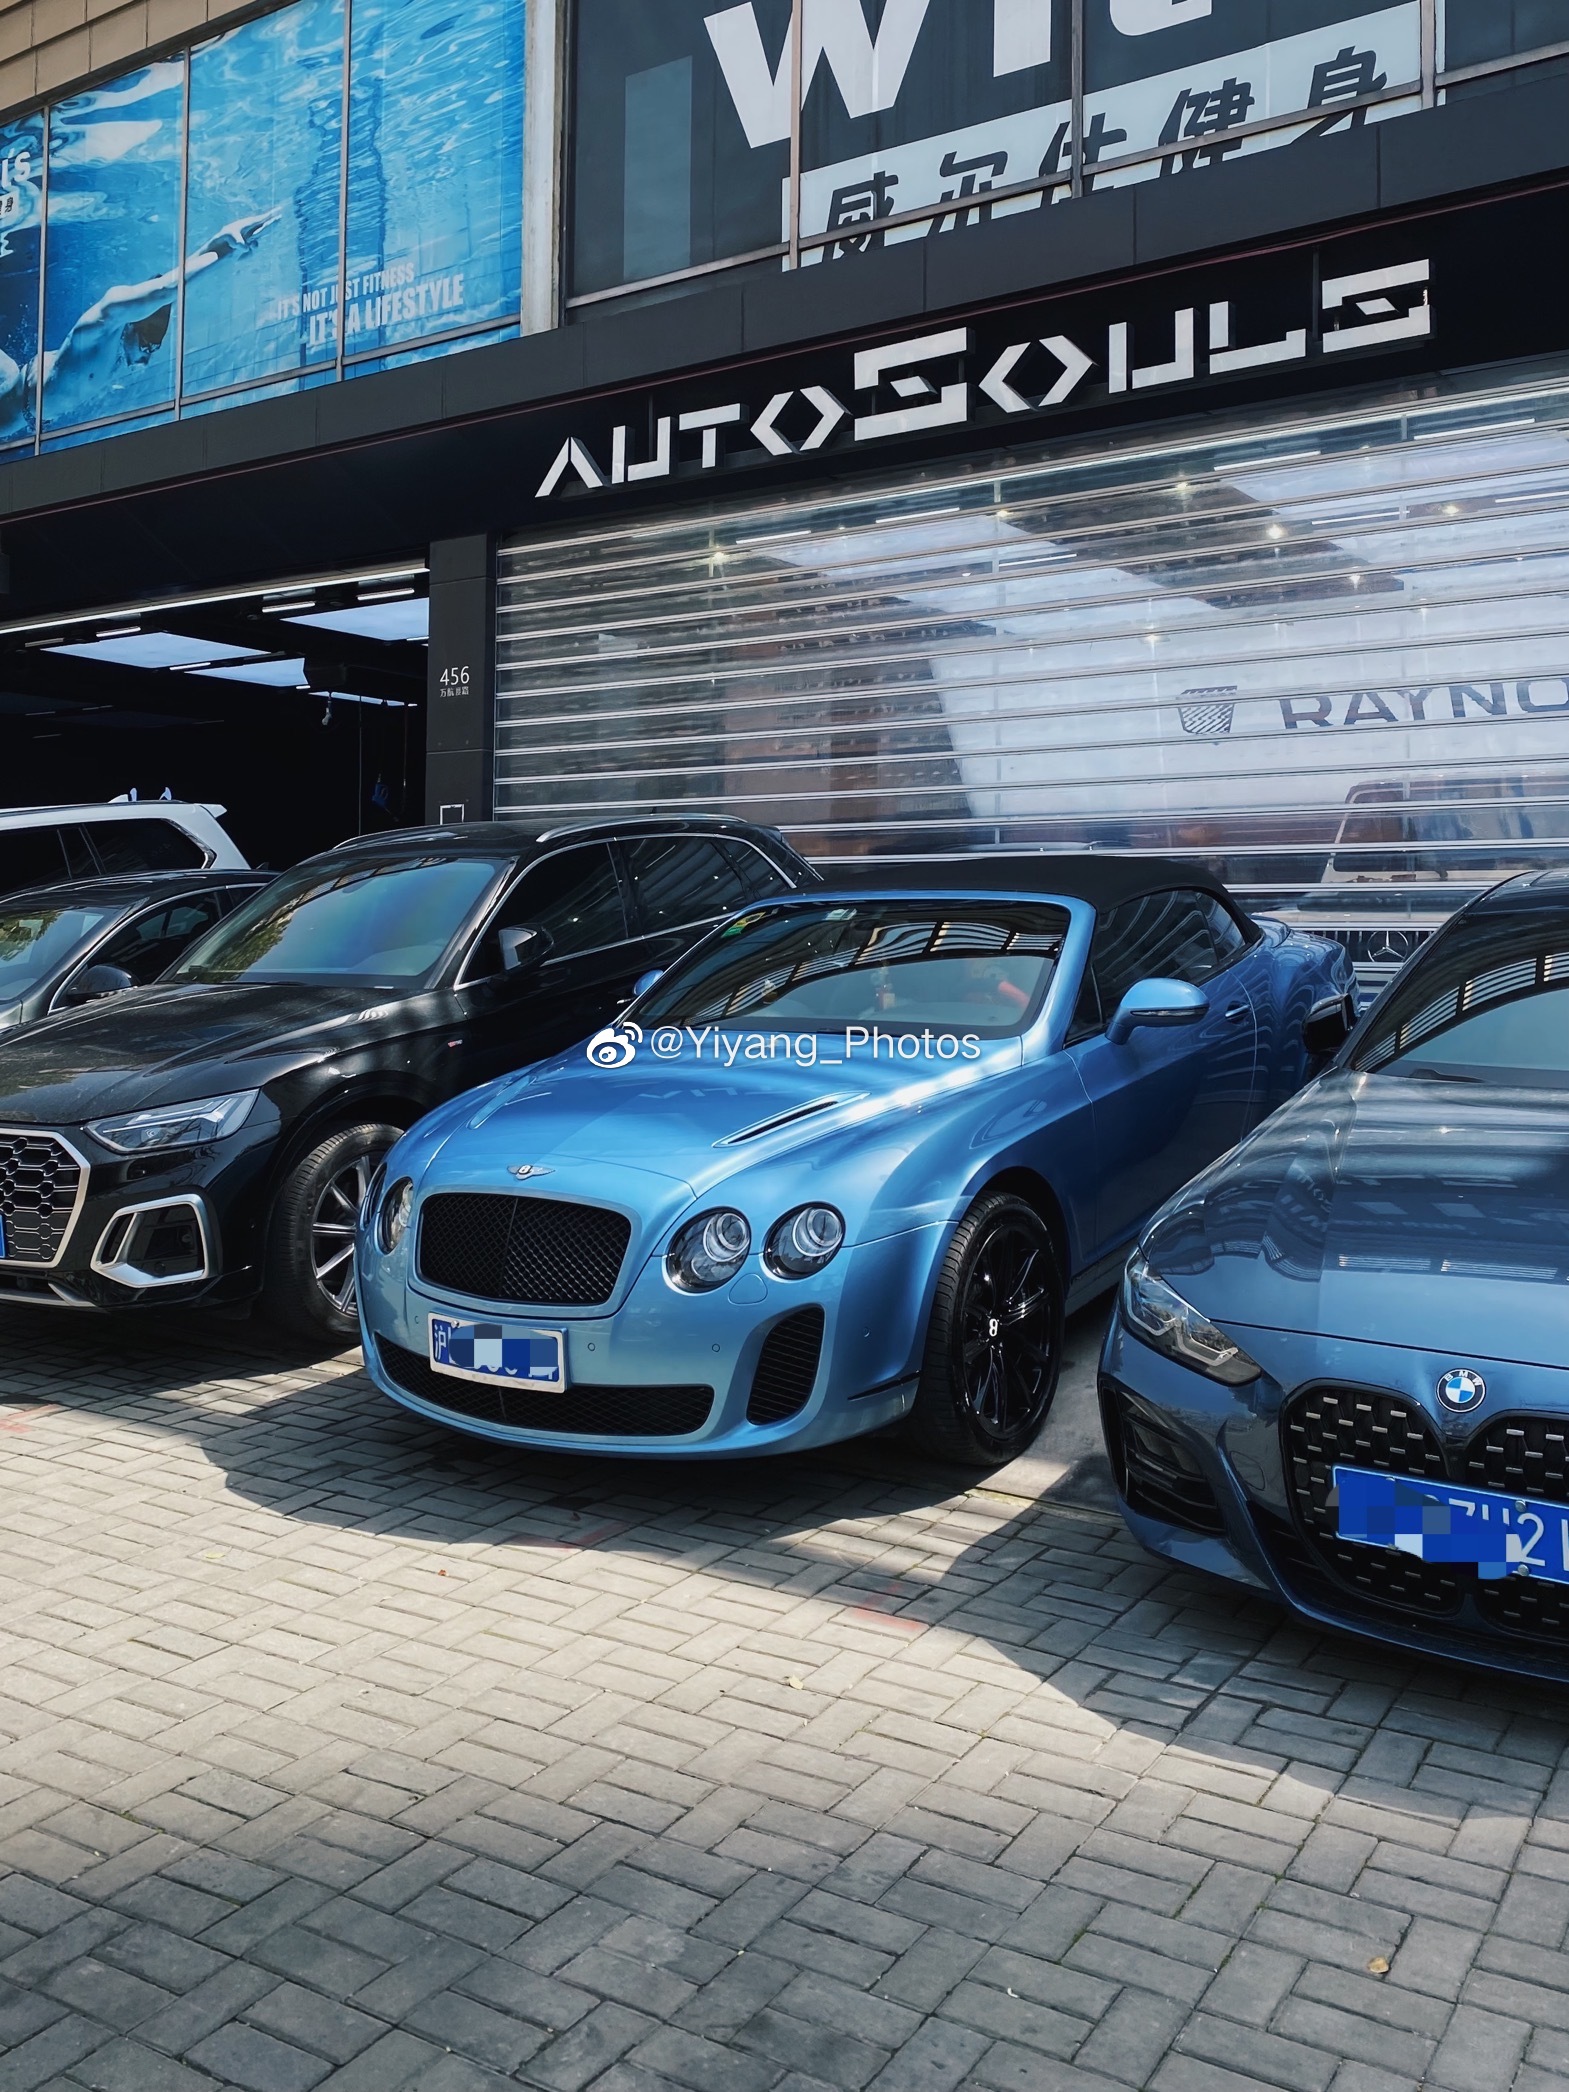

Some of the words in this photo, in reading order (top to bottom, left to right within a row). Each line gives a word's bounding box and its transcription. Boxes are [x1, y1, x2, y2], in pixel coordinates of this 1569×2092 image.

[277, 296, 300, 320] IT'S
[303, 287, 328, 313] NOT
[330, 277, 360, 305] JST
[363, 262, 415, 296] FITNESS
[347, 302, 361, 335] A
[365, 273, 465, 330] LIFESTYLE
[534, 258, 1431, 498] AUTOSOULS
[439, 665, 470, 686] 456
[1443, 1370, 1482, 1386] BMW
